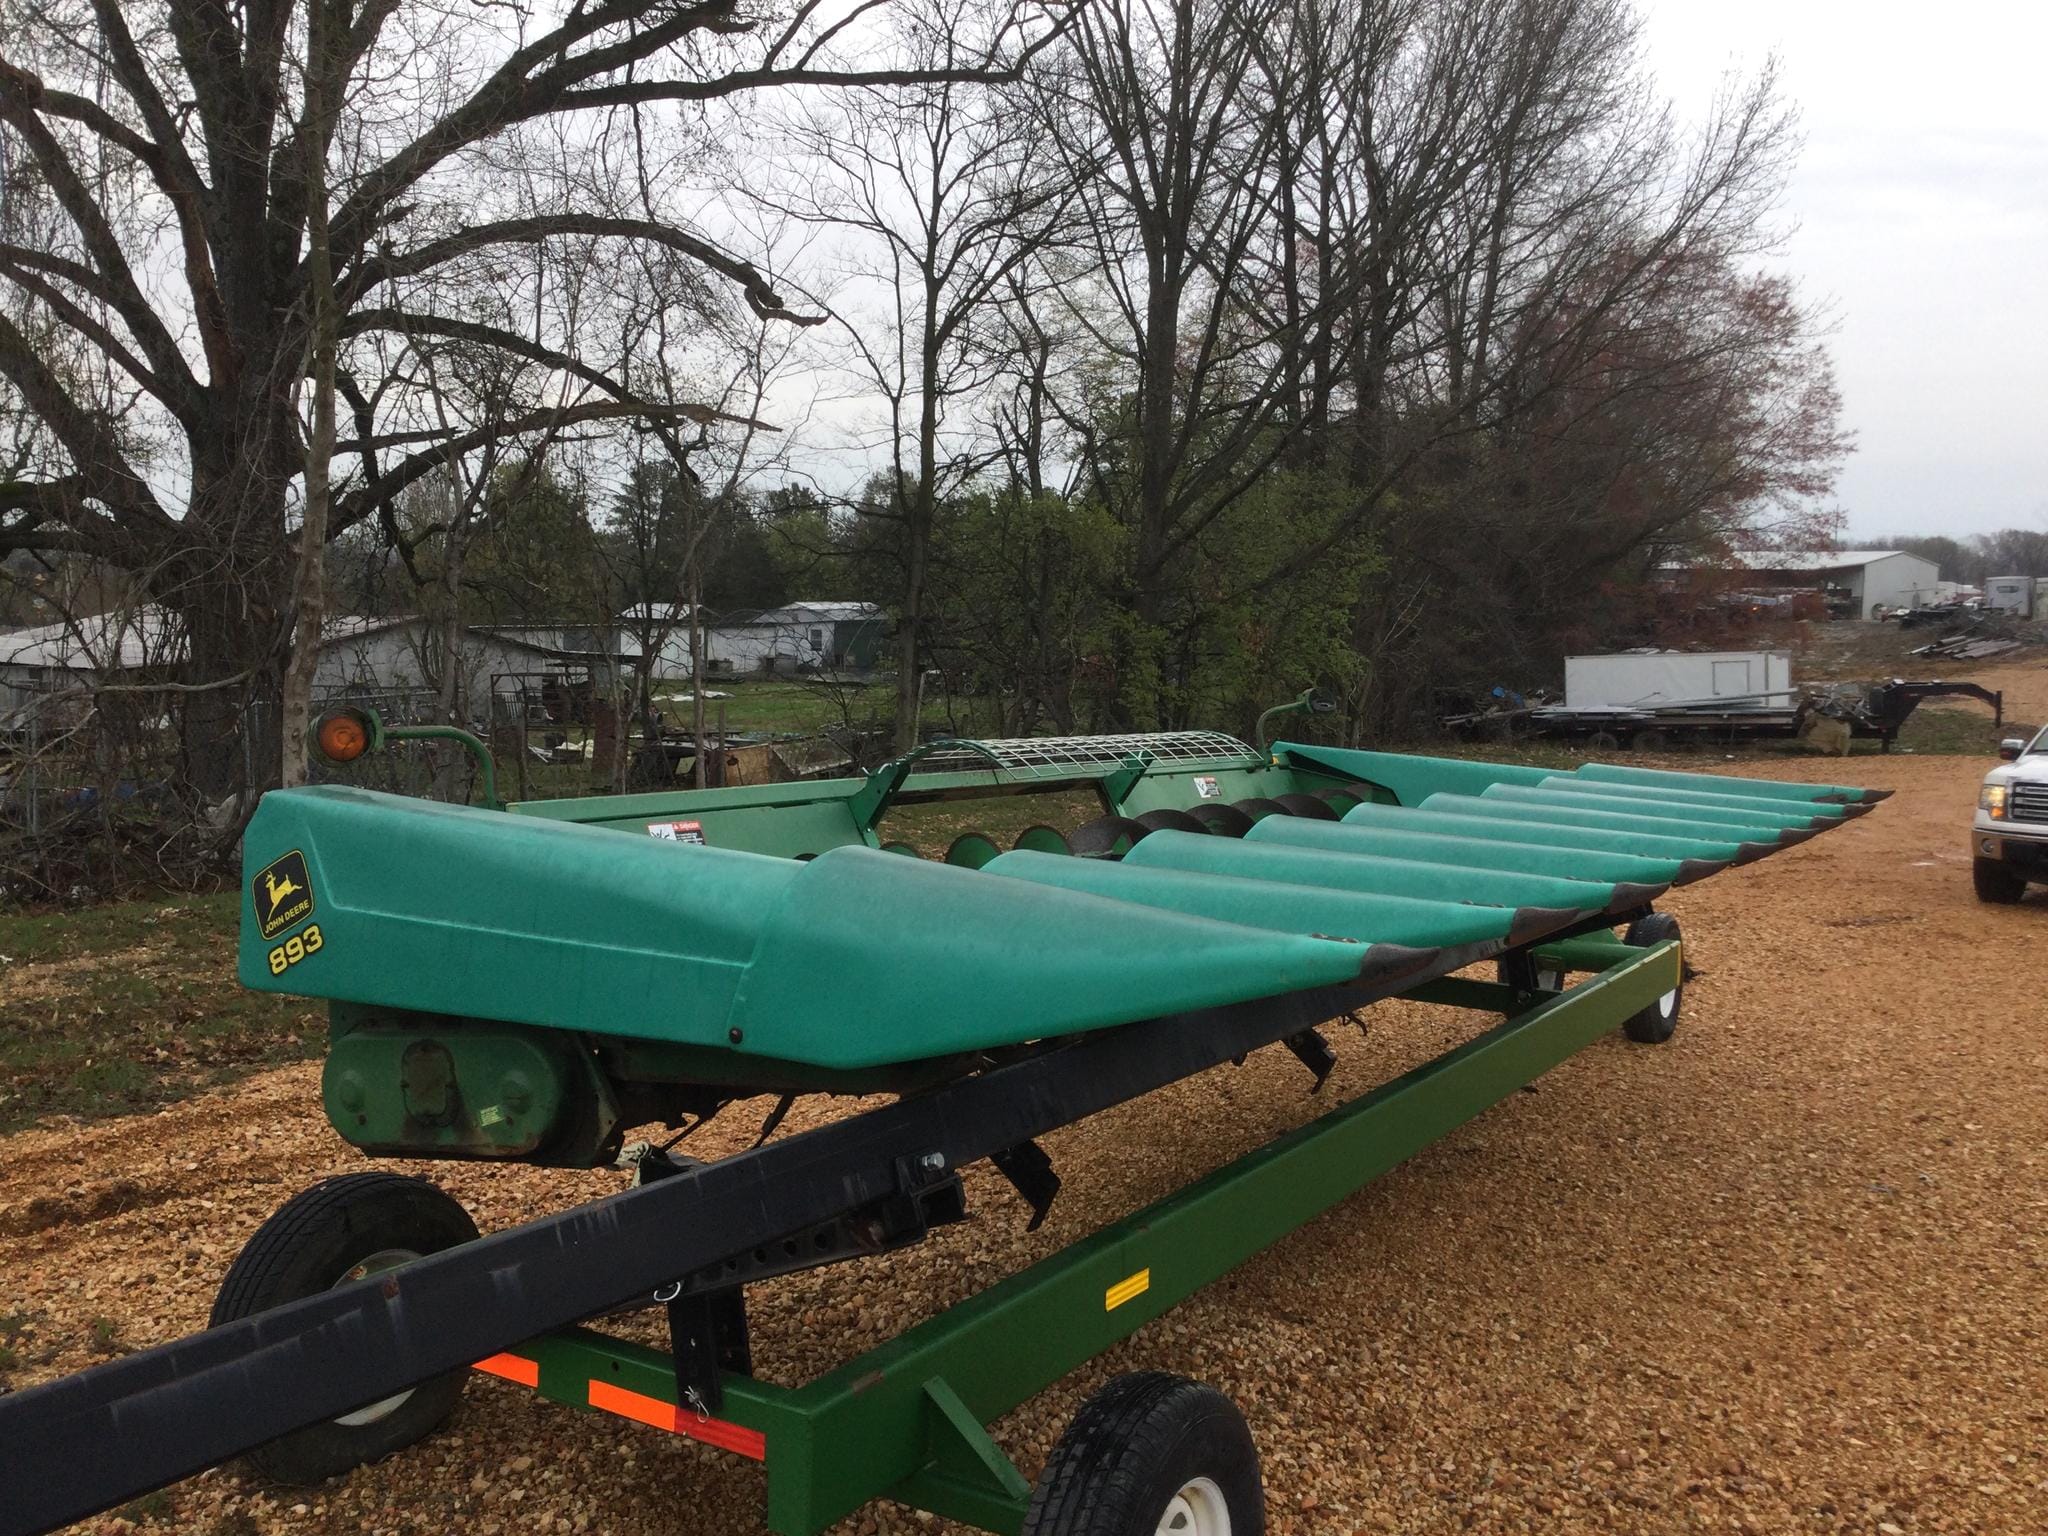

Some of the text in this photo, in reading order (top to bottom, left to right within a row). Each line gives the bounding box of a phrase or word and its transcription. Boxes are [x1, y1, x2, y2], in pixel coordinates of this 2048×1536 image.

[264, 900, 310, 934] JOHN DEERE
[268, 924, 324, 975] 893
